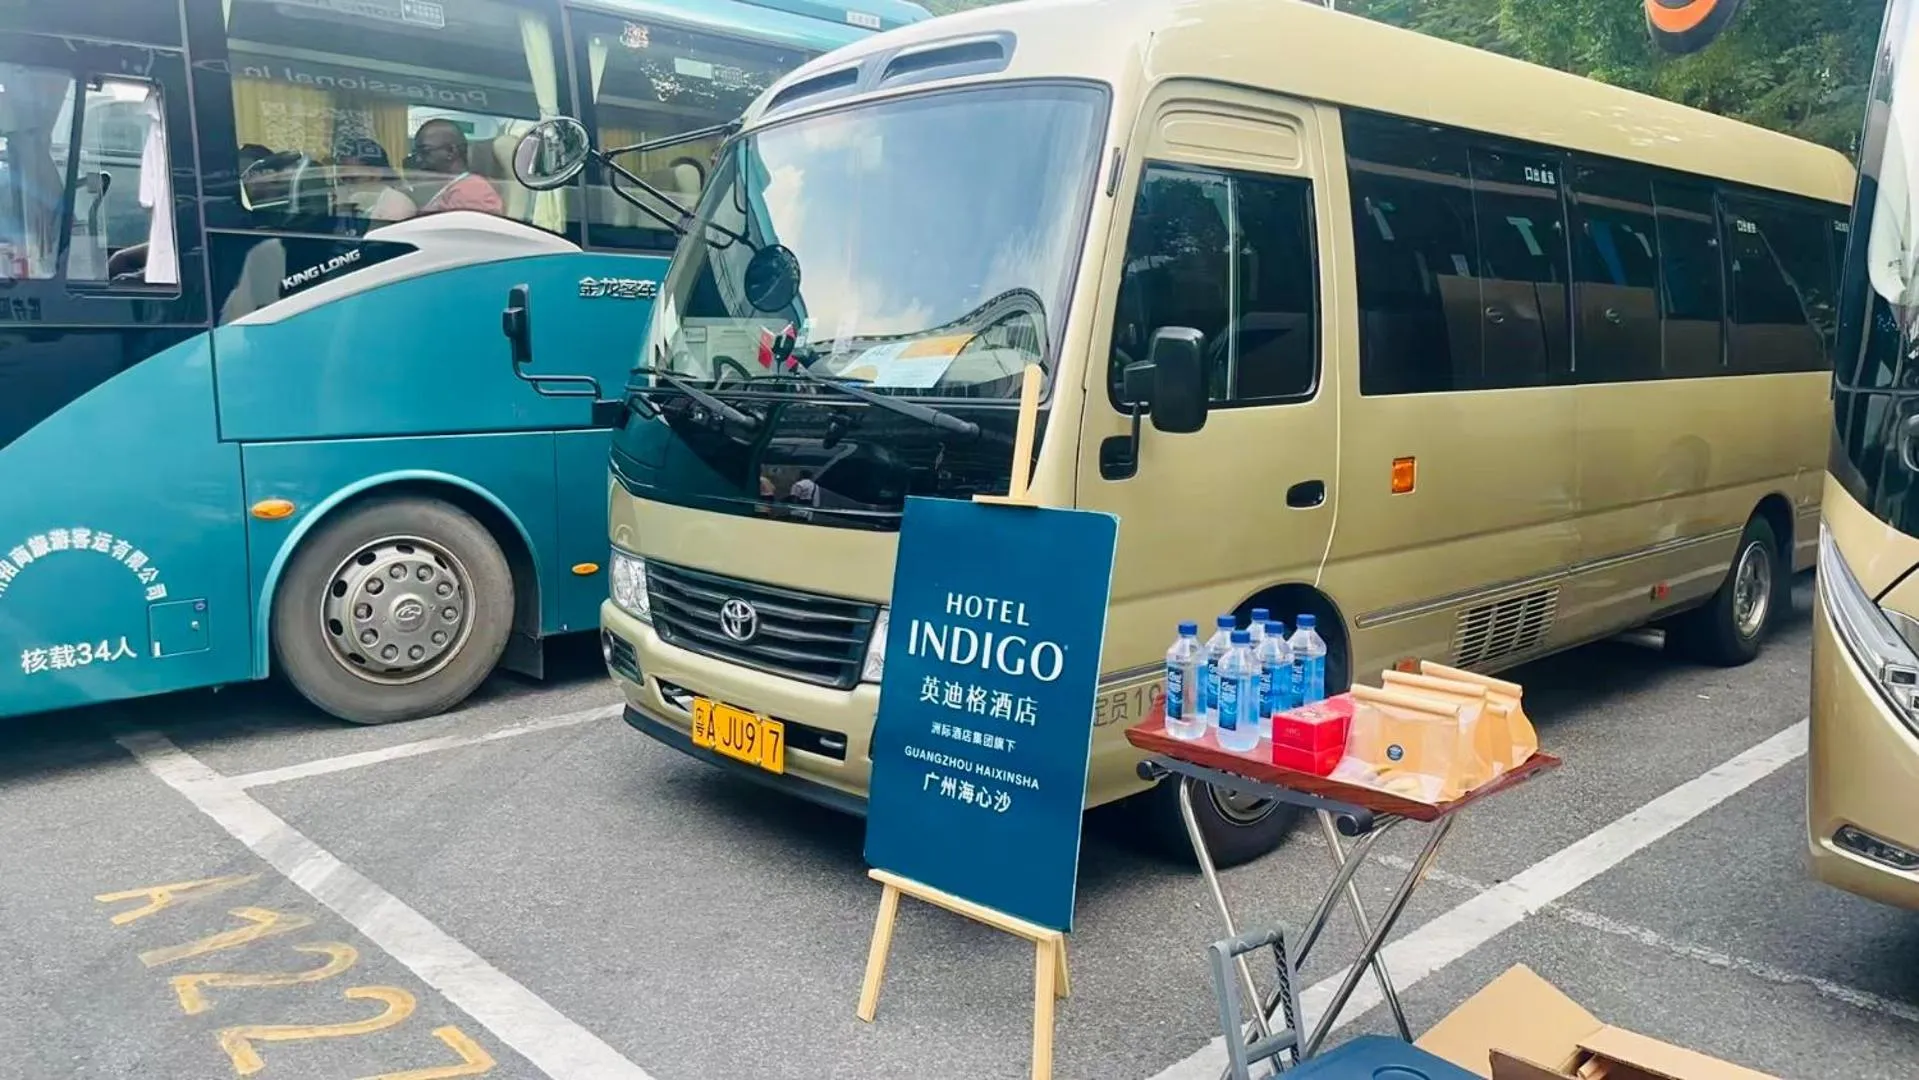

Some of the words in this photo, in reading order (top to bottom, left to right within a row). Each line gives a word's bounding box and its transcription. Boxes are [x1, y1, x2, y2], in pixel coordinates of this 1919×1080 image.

[281, 265, 320, 290] KING
[318, 248, 361, 275] LONG
[578, 276, 657, 298] 金龙客车
[0, 527, 168, 601] 招商旅游客运有限公司
[946, 592, 1030, 626] HOTEL
[21, 635, 138, 675] 核载34人
[908, 619, 1064, 682] INDIGO
[920, 675, 1038, 726] 英迪格酒店
[931, 721, 1016, 752] 洲际酒店集团旗下
[904, 745, 973, 772] GUANGZHOU
[975, 763, 1040, 790] HAIXINSHA
[923, 771, 1012, 813] 广州海心沙
